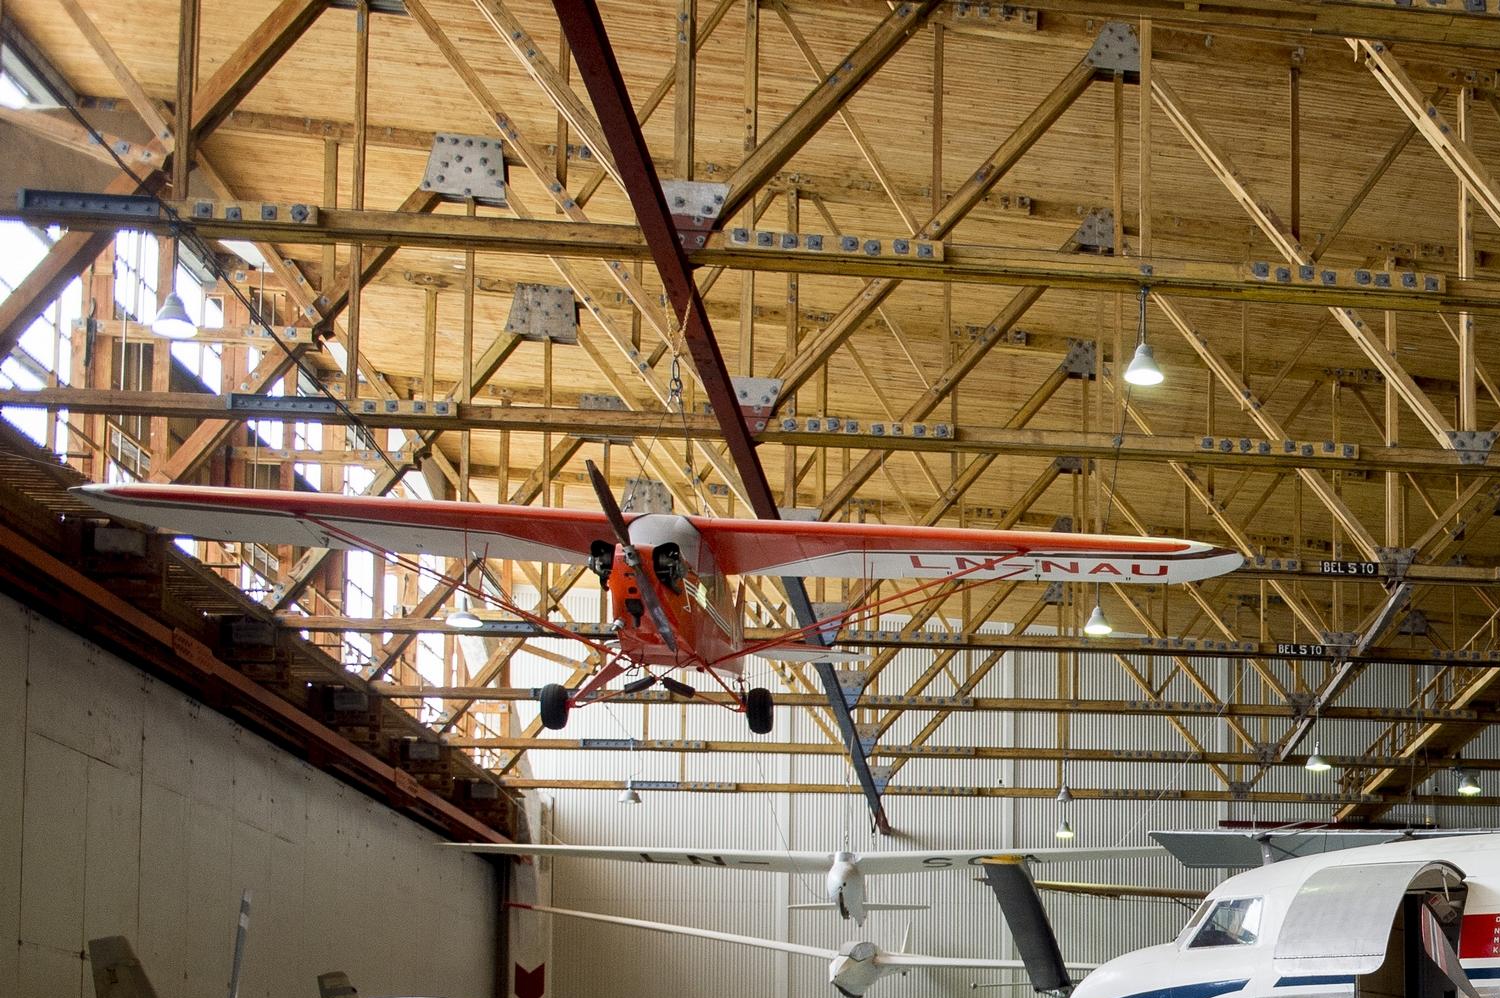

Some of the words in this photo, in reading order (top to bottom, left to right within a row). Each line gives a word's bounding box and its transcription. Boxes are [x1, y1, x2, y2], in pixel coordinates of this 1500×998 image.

[910, 555, 1168, 576] LN-NAU
[1323, 561, 1345, 574] BEL
[1348, 562, 1357, 574] 5
[1361, 563, 1375, 574] TO
[1278, 644, 1297, 655] BEL
[1299, 645, 1308, 655] 5
[1311, 645, 1323, 655] TO
